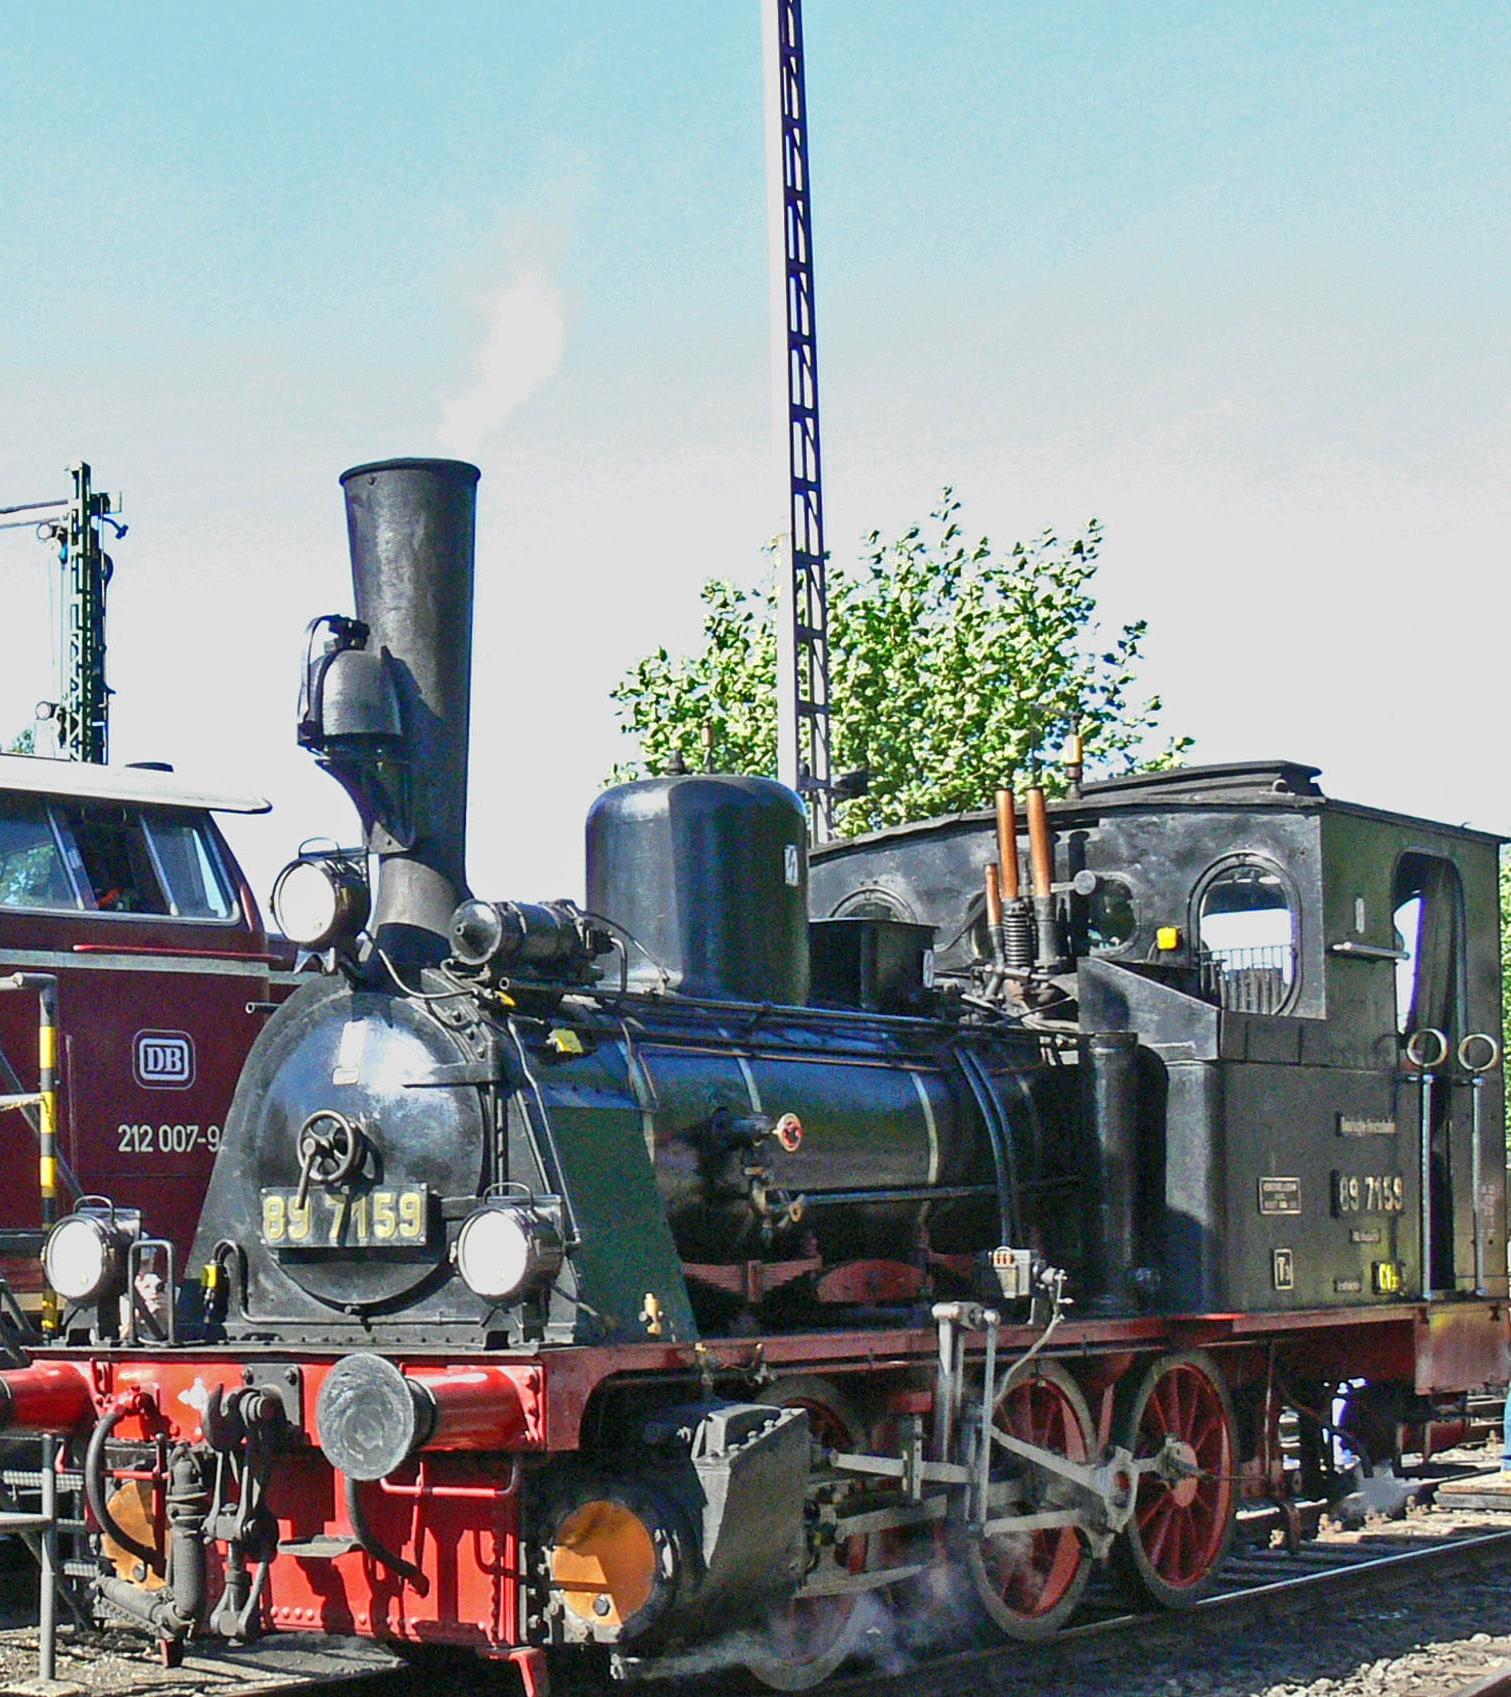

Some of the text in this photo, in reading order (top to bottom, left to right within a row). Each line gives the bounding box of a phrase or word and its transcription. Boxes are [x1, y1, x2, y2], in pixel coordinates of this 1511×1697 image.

[145, 1046, 183, 1072] DB
[117, 1124, 221, 1153] 212 007-9
[1339, 1176, 1359, 1211] 89
[1364, 1176, 1404, 1211] 7159
[262, 1192, 422, 1240] 89 7159
